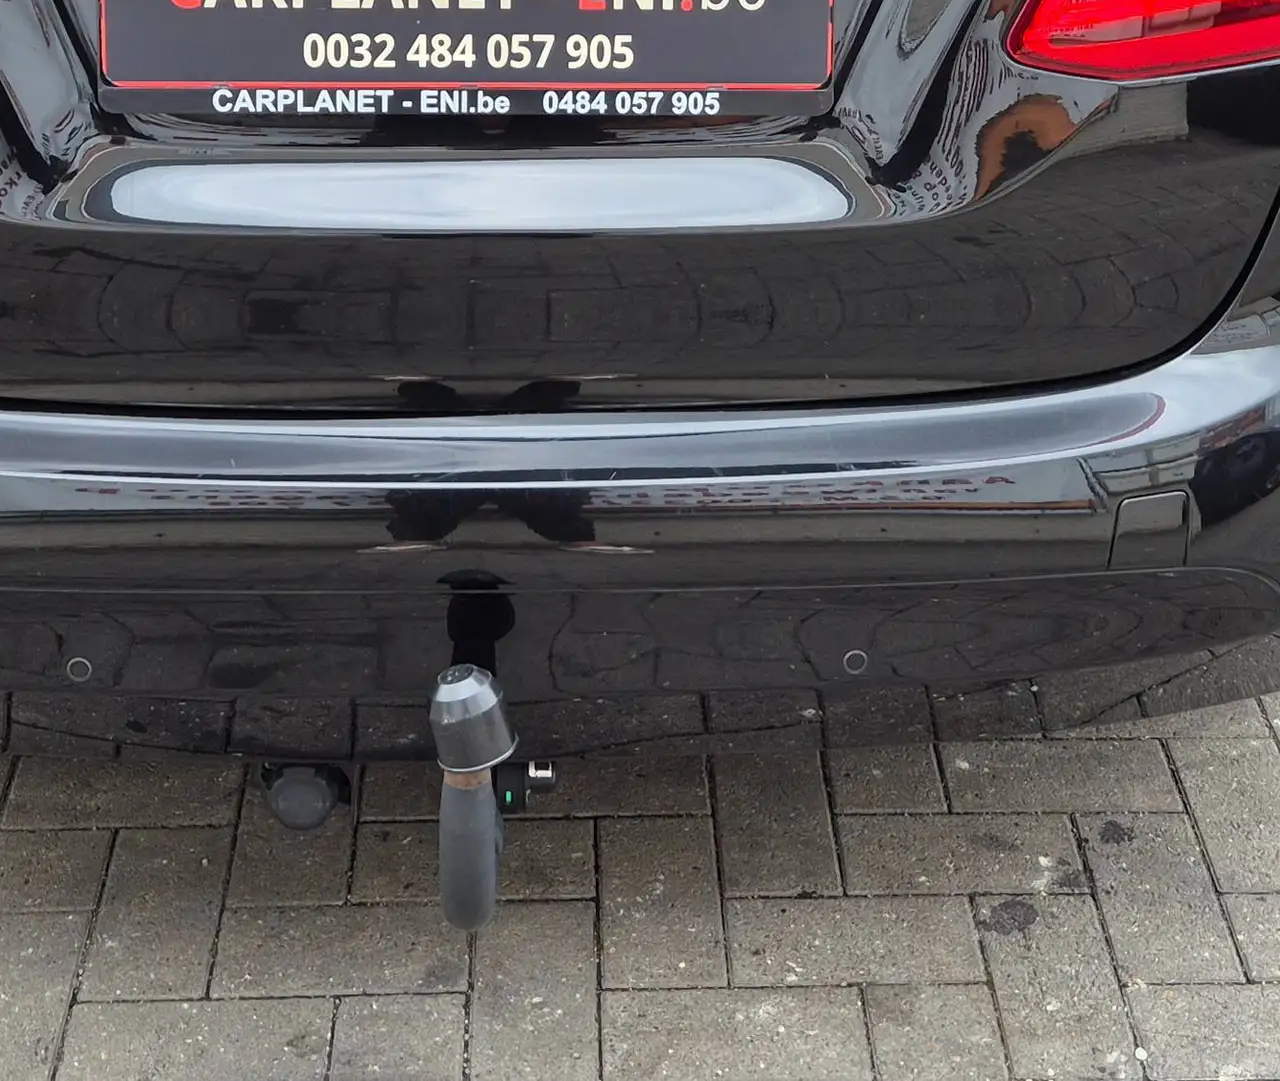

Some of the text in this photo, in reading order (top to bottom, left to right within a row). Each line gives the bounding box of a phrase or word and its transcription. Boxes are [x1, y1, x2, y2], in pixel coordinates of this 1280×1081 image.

[303, 32, 634, 70] 0032 484 057 905
[212, 88, 394, 113] CARPLANET
[420, 89, 511, 114] ENI.be
[542, 90, 607, 115] 0484
[615, 91, 663, 115] 057
[671, 91, 720, 116] 905
